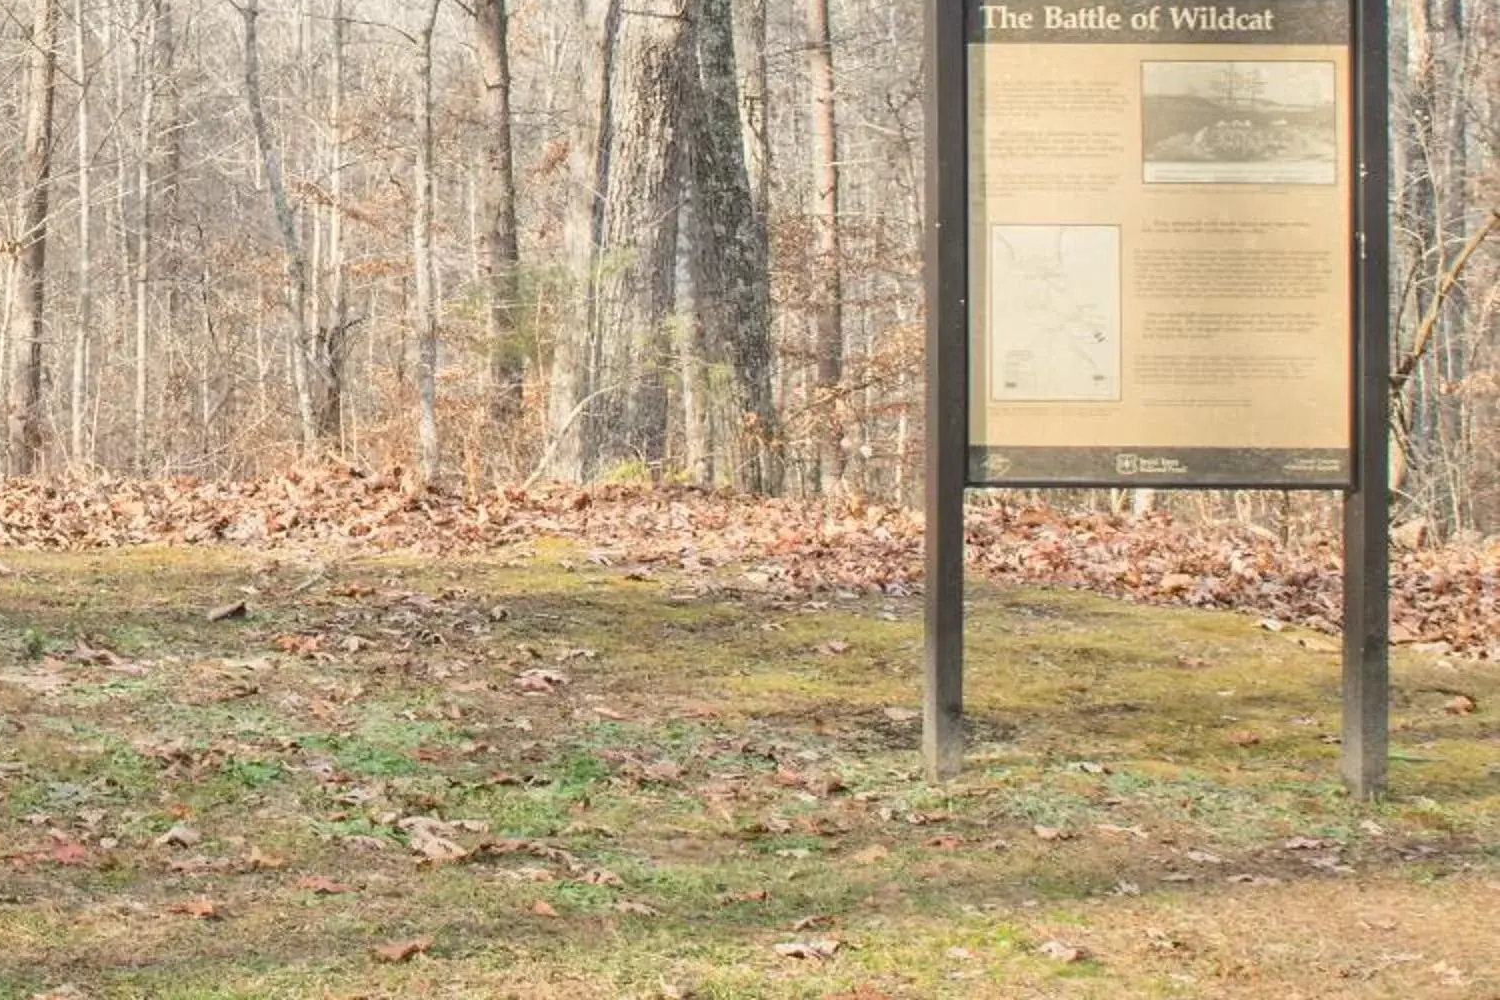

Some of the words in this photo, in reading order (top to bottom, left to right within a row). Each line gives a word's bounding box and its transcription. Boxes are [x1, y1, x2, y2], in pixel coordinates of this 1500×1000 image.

[980, 6, 1033, 29] The
[1044, 5, 1121, 30] Battle
[1131, 5, 1161, 31] of
[1170, 6, 1276, 31] Wildcat
